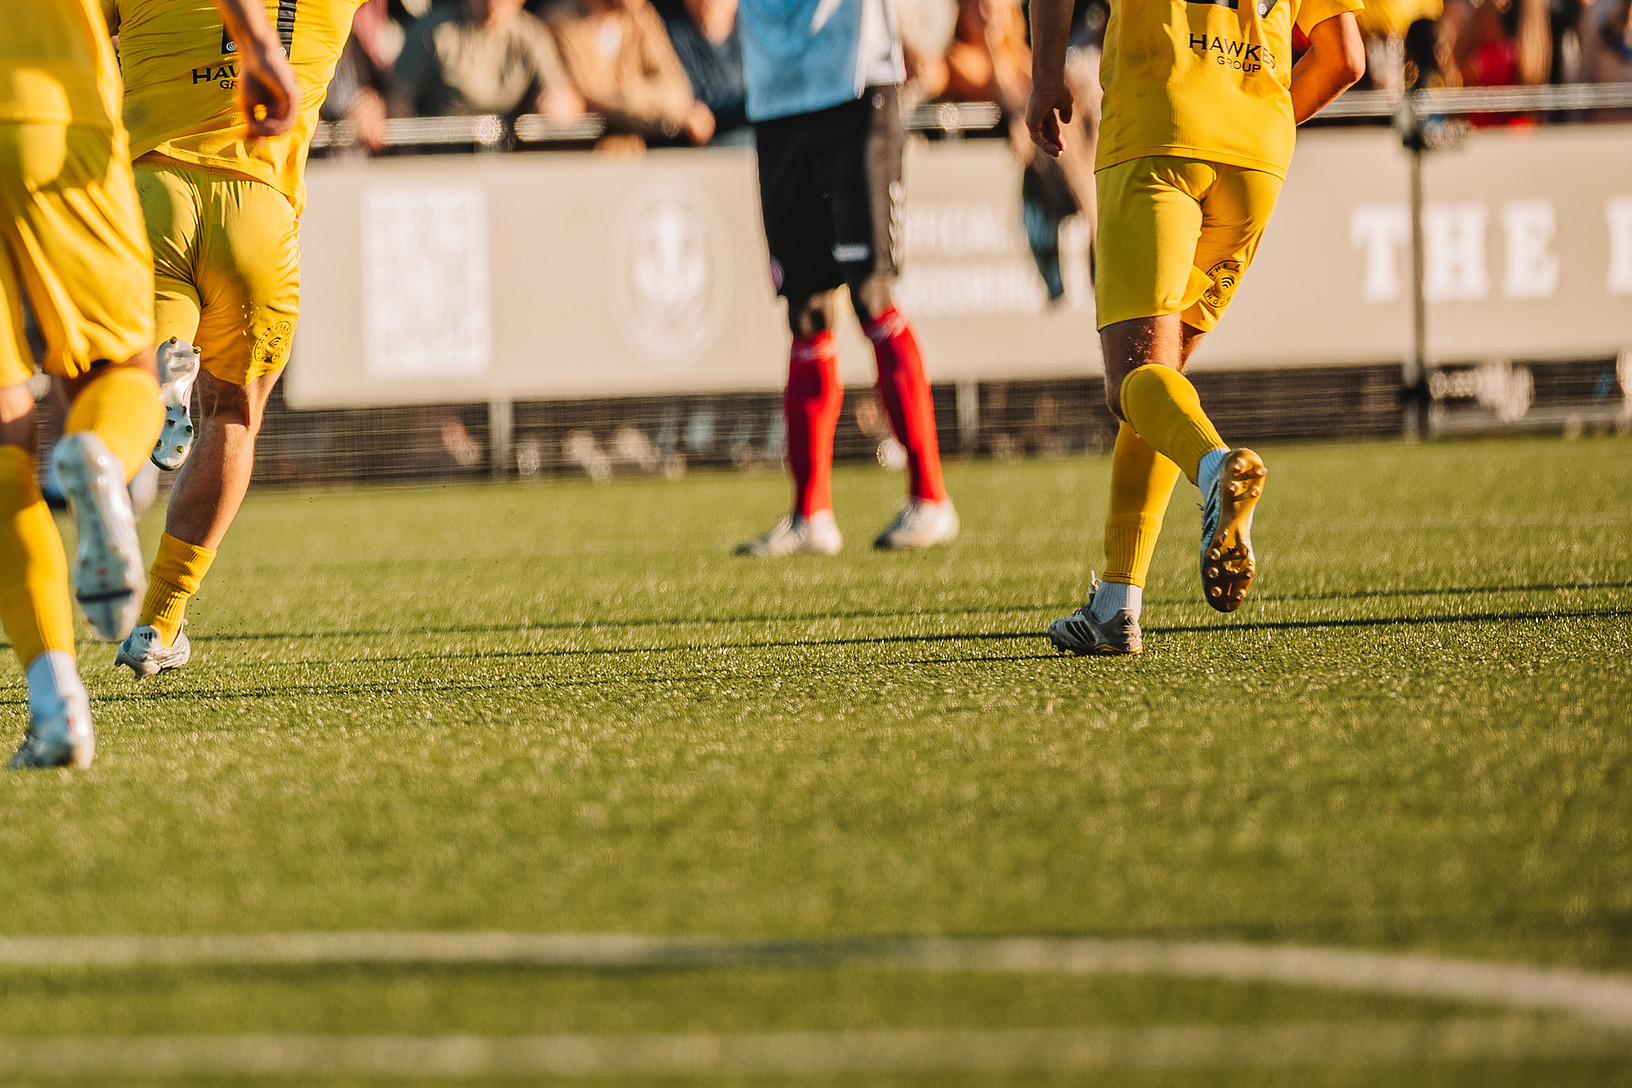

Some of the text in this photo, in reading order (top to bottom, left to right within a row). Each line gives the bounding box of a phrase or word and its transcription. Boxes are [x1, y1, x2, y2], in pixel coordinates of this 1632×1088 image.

[1189, 32, 1276, 70] HAWKES
[1216, 55, 1262, 73] GROUP
[1349, 199, 1560, 302] THE
